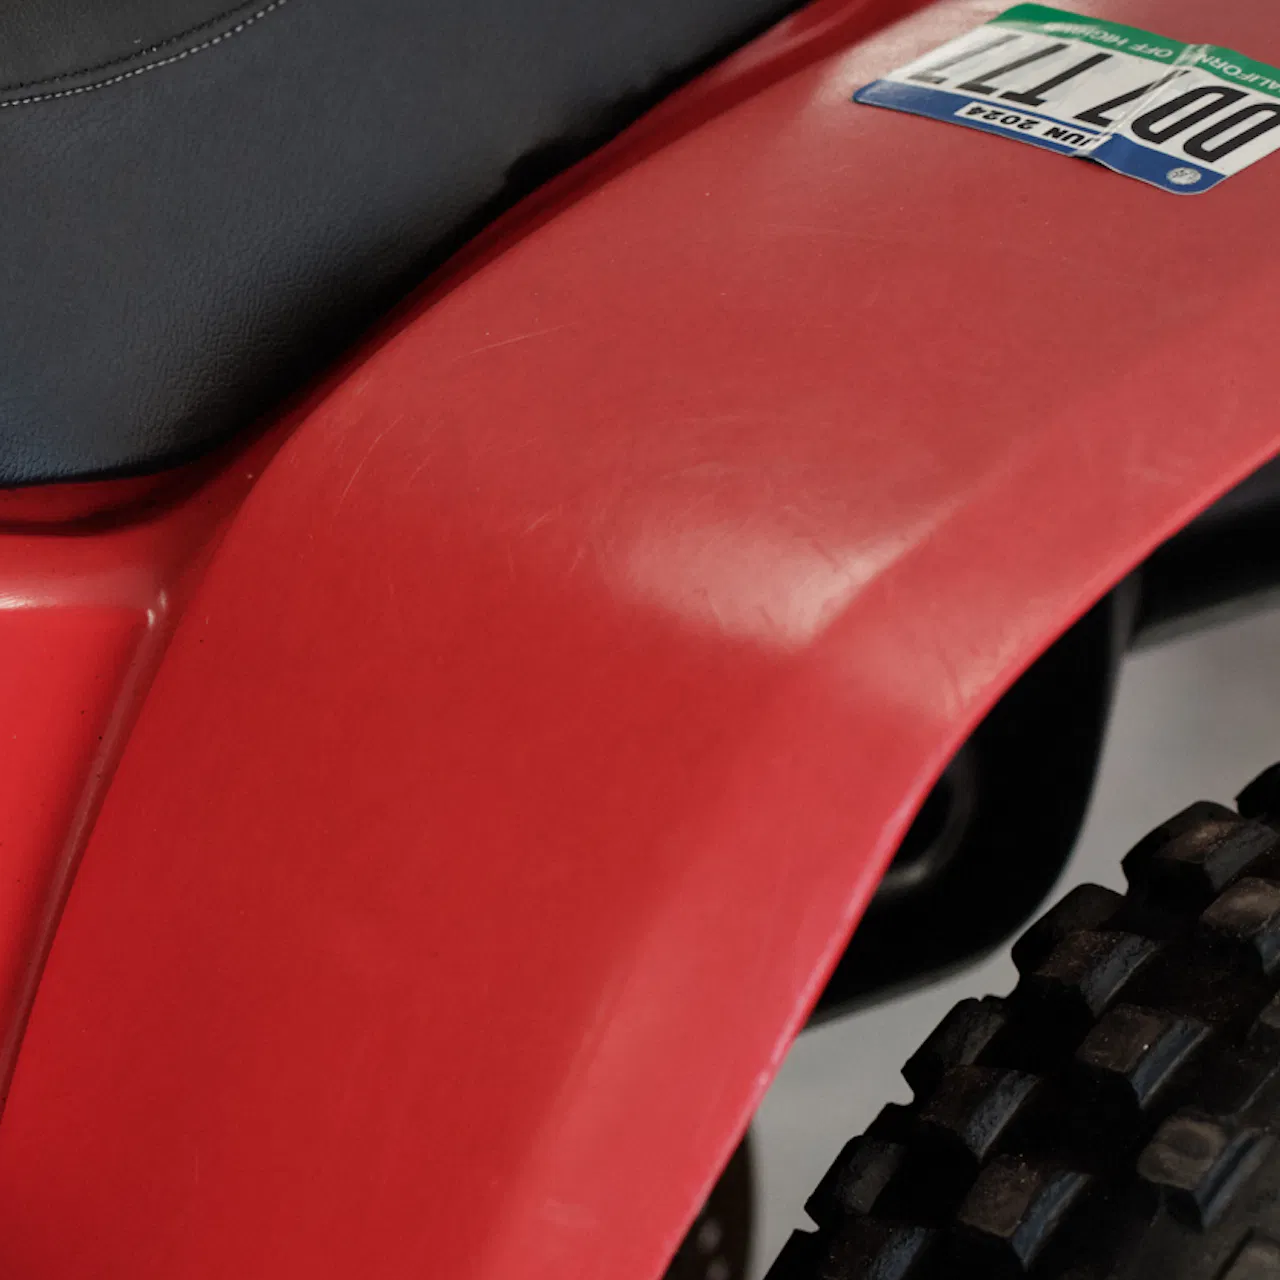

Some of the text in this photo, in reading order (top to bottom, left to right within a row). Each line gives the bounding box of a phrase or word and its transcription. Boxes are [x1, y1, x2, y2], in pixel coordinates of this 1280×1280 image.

[1128, 43, 1173, 58] OFF
[967, 106, 1098, 147] JUN 2024
